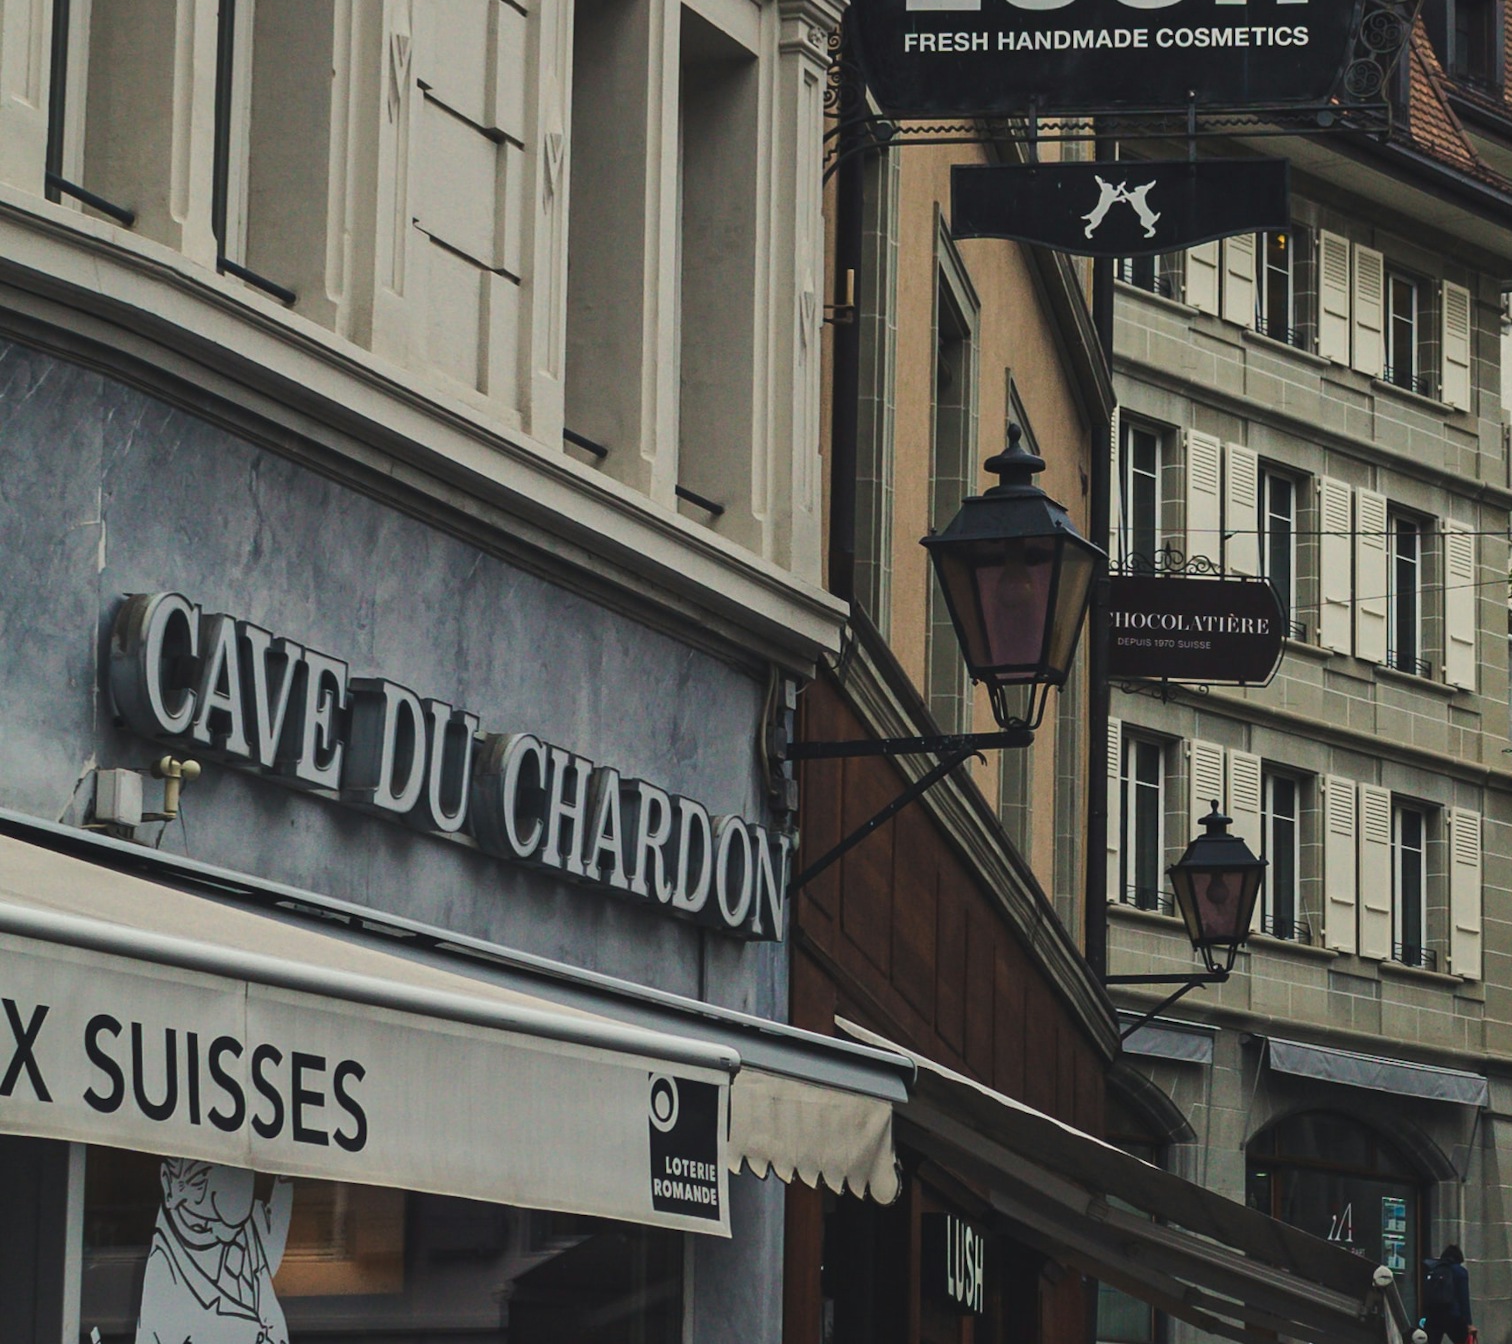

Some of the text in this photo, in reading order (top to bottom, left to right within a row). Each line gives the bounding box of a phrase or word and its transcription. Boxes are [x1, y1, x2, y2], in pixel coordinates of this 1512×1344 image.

[904, 25, 1310, 53] FRESH HANDMADE COSMETICS
[1117, 636, 1212, 650] DEPUIS 1970 SUISSE
[118, 591, 797, 944] CAVE DU CHARDON
[83, 1013, 368, 1153] SUISSES
[665, 1155, 717, 1183] LOTERIE
[653, 1177, 718, 1206] ROMANDE
[946, 1213, 985, 1315] LUSH
